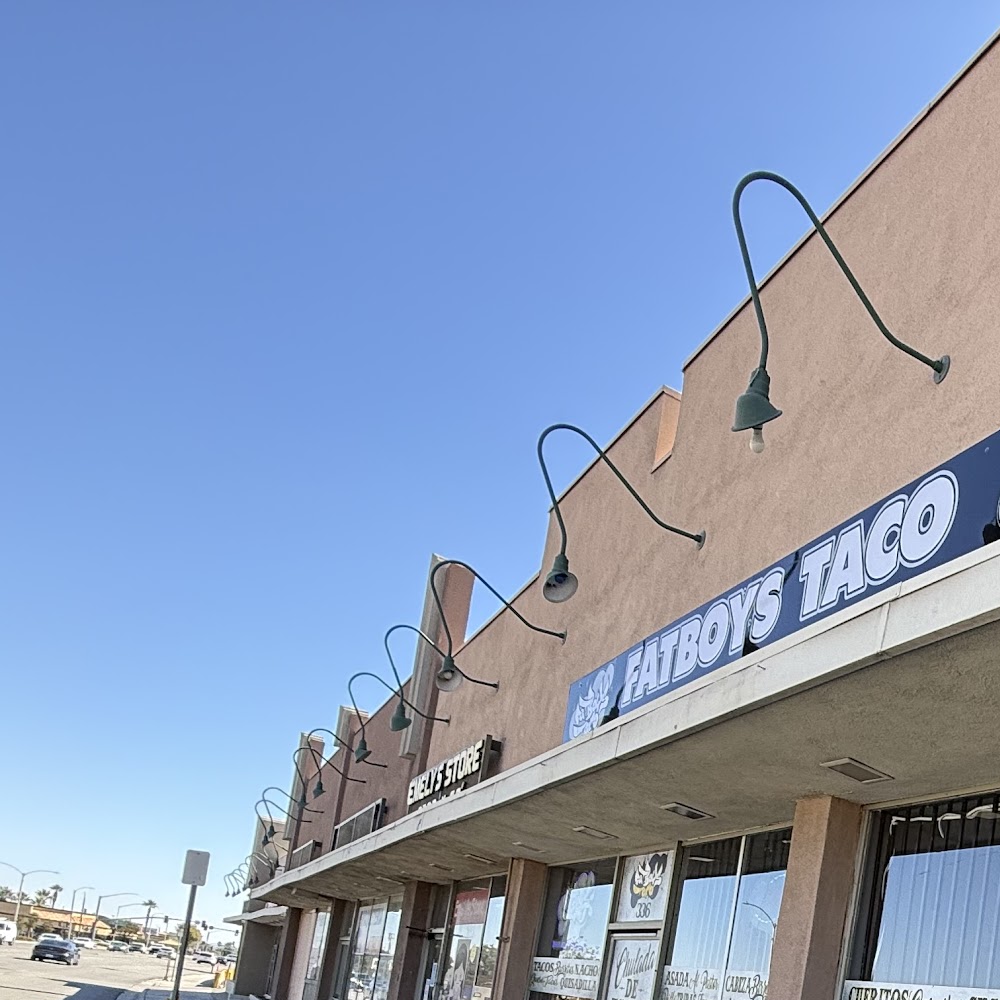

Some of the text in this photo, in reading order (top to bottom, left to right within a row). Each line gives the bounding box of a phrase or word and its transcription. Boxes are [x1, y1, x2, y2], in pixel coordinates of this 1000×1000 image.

[620, 567, 785, 707] FATBOYS
[799, 469, 959, 622] TACO
[444, 739, 483, 787] STORE
[636, 903, 651, 918] 336
[575, 964, 600, 976] NACHO
[614, 944, 655, 989] Chulada
[664, 971, 689, 986] ASADA
[726, 976, 751, 993] CABEZA
[625, 979, 639, 998] DE
